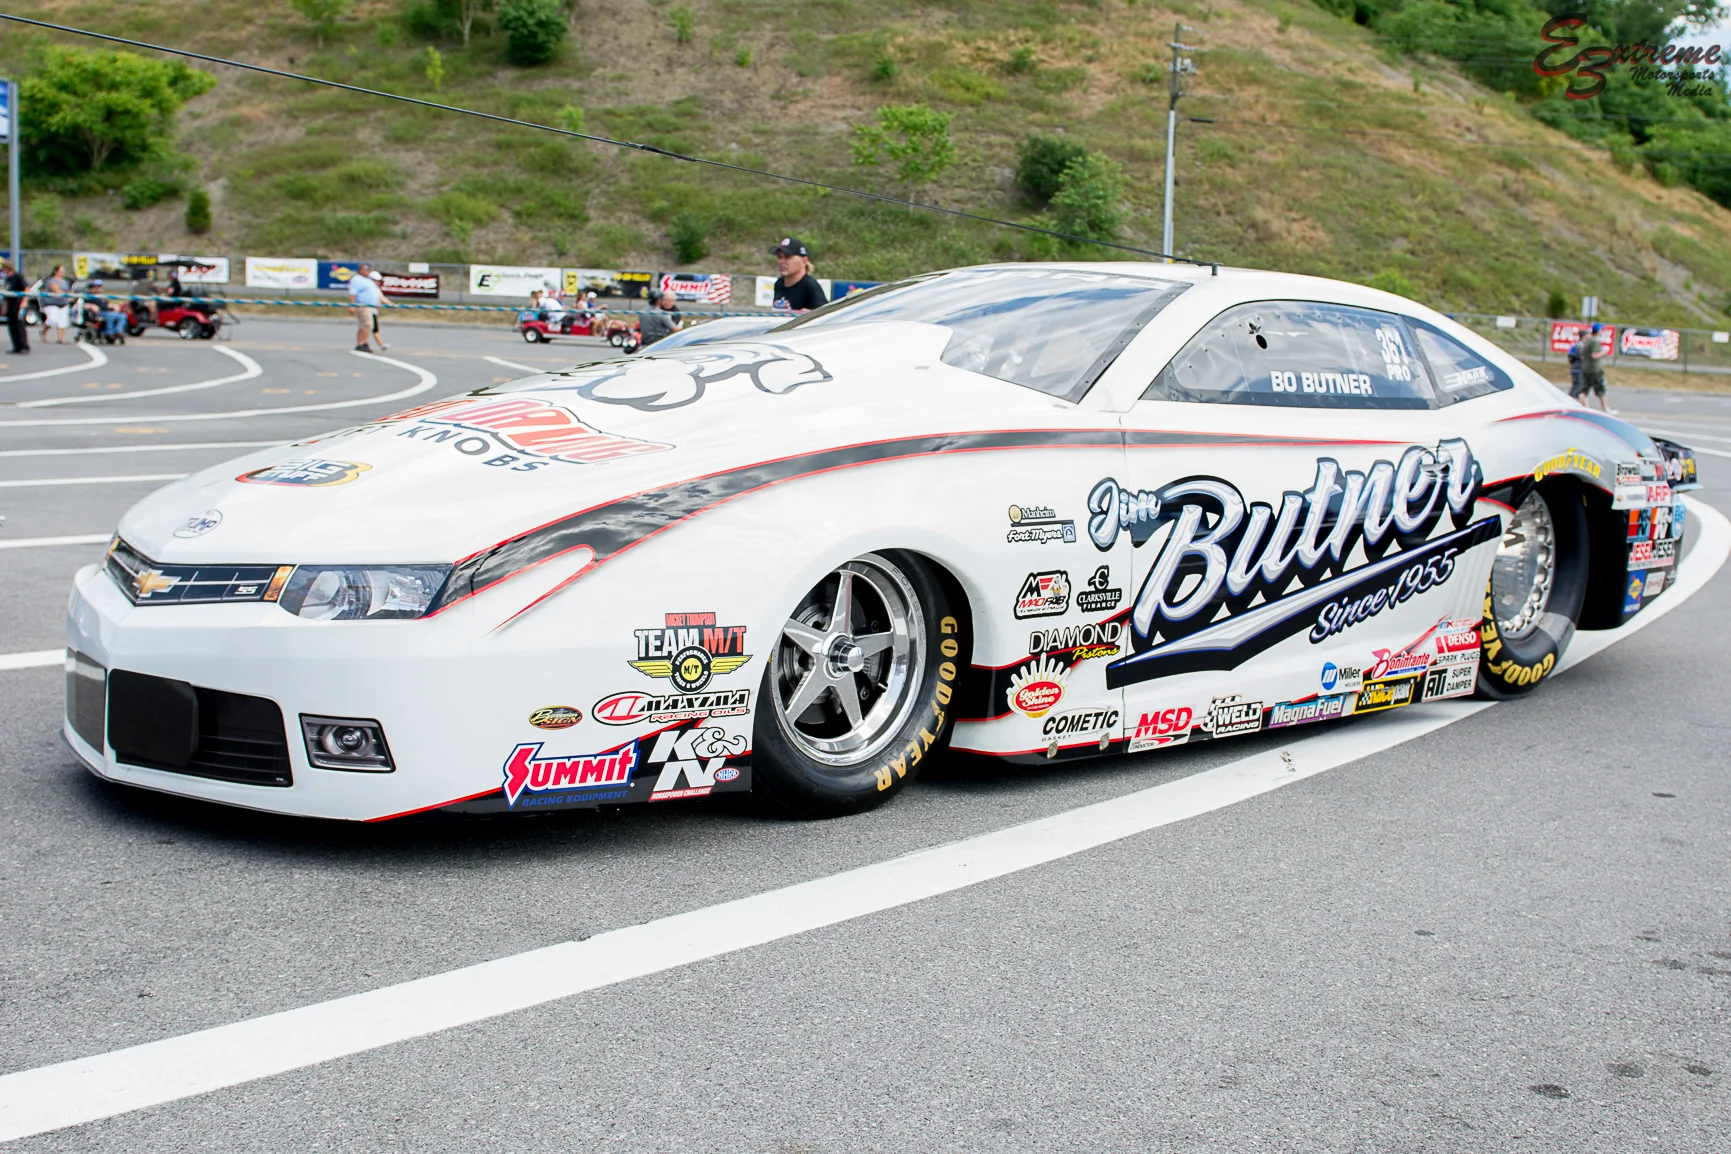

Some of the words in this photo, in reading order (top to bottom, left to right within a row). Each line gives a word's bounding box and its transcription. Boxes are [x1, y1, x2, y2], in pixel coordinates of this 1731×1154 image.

[1385, 363, 1411, 382] PRO
[1271, 371, 1297, 393] BO
[1302, 372, 1373, 395] BUTNER
[397, 425, 549, 472] KNOBS
[1534, 447, 1602, 482] GOODYEAR
[1020, 506, 1056, 520] Manheim
[1088, 477, 1161, 551] Jim
[1007, 530, 1031, 543] Fort
[1031, 528, 1063, 544] Myers
[1131, 438, 1483, 645] Butner
[236, 586, 258, 595] SS
[1078, 591, 1121, 603] CLARKSVILLE
[1309, 597, 1389, 643] Since
[1388, 548, 1458, 609] 1955
[1083, 601, 1116, 609] FINANCE
[634, 627, 699, 657] TEAM
[703, 625, 746, 655] M/T
[1029, 622, 1122, 654] DIAMOND
[1447, 632, 1477, 646] DENSO
[1072, 646, 1119, 662] Pistons
[1437, 653, 1458, 664] SPARK
[1460, 651, 1480, 662] PLUGS
[683, 664, 699, 675] M/T
[1372, 648, 1430, 680] Boninfante
[1451, 666, 1472, 679] SUPER
[1338, 667, 1361, 681] Miller
[1425, 668, 1448, 698] ATI
[1446, 679, 1472, 692] DAMPER
[1019, 686, 1060, 702] Golden
[1022, 696, 1055, 707] Shine
[873, 616, 959, 792] GOODYEAR
[1269, 693, 1348, 727] MagnaFuel
[650, 709, 709, 723] RACING
[710, 706, 747, 718] OILS
[1217, 702, 1263, 724] WELD
[1042, 709, 1120, 736] COMETIC
[1134, 706, 1193, 738] MSD
[1216, 720, 1259, 733] RACING
[716, 769, 738, 781] NHRA
[521, 795, 564, 807] RACING
[565, 790, 628, 804] EQUIPMENT
[651, 790, 684, 800] HORSEPOWER
[683, 787, 711, 796] CHALLENGE
